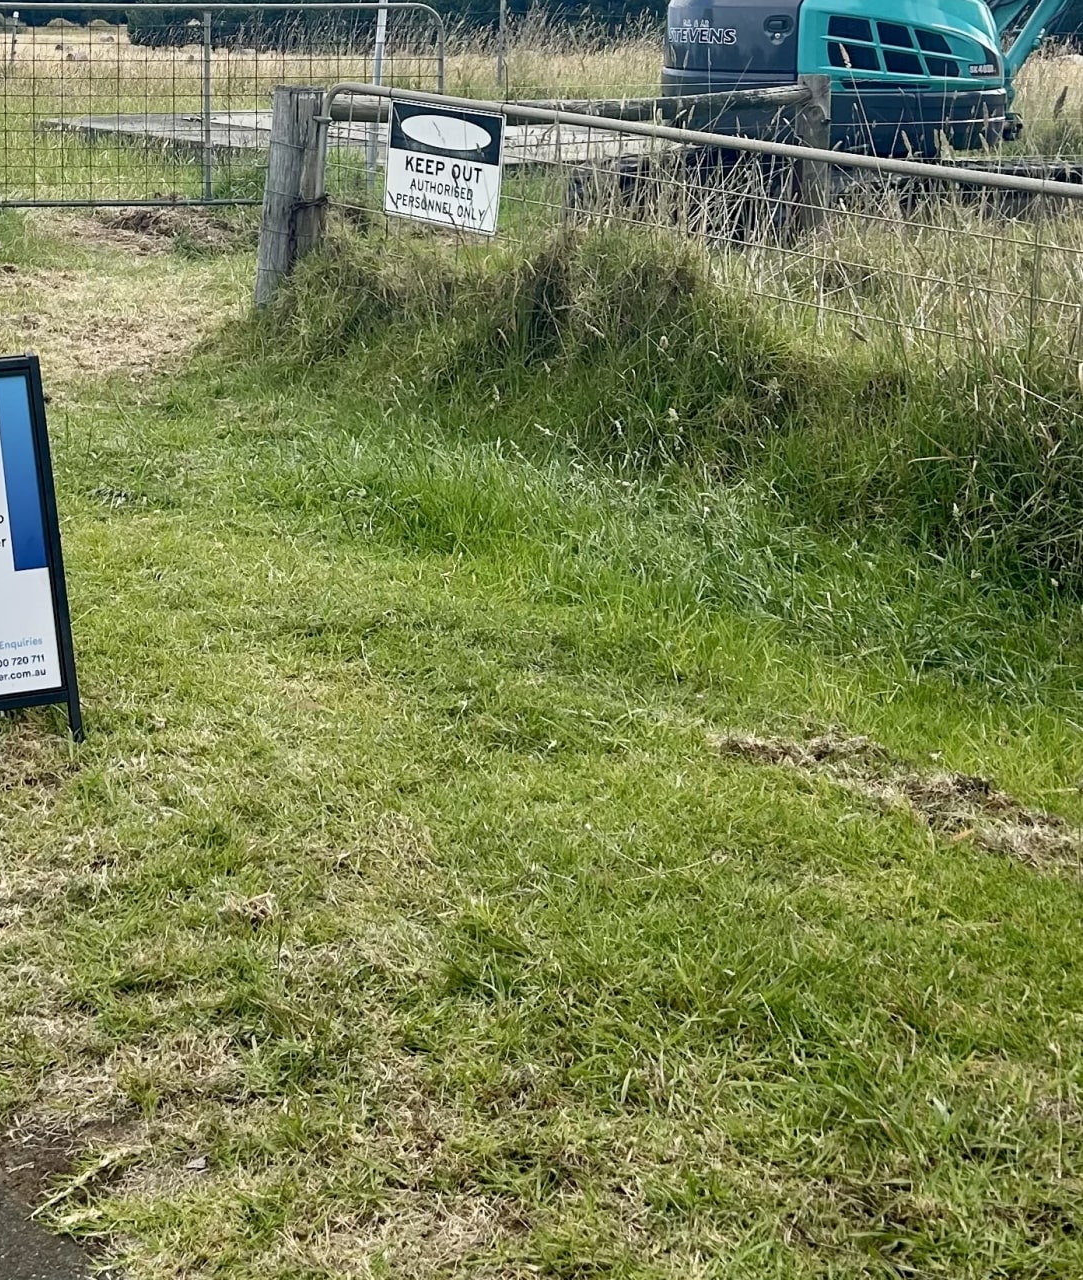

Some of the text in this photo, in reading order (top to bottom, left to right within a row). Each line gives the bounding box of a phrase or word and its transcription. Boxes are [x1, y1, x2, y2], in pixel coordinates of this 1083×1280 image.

[669, 27, 737, 45] STEVENS
[405, 155, 482, 183] KEEP OUT
[409, 178, 473, 201] AUTHORISED
[396, 193, 485, 221] PERSONNEL ONLY
[11, 656, 29, 666] 720
[31, 654, 45, 664] 711
